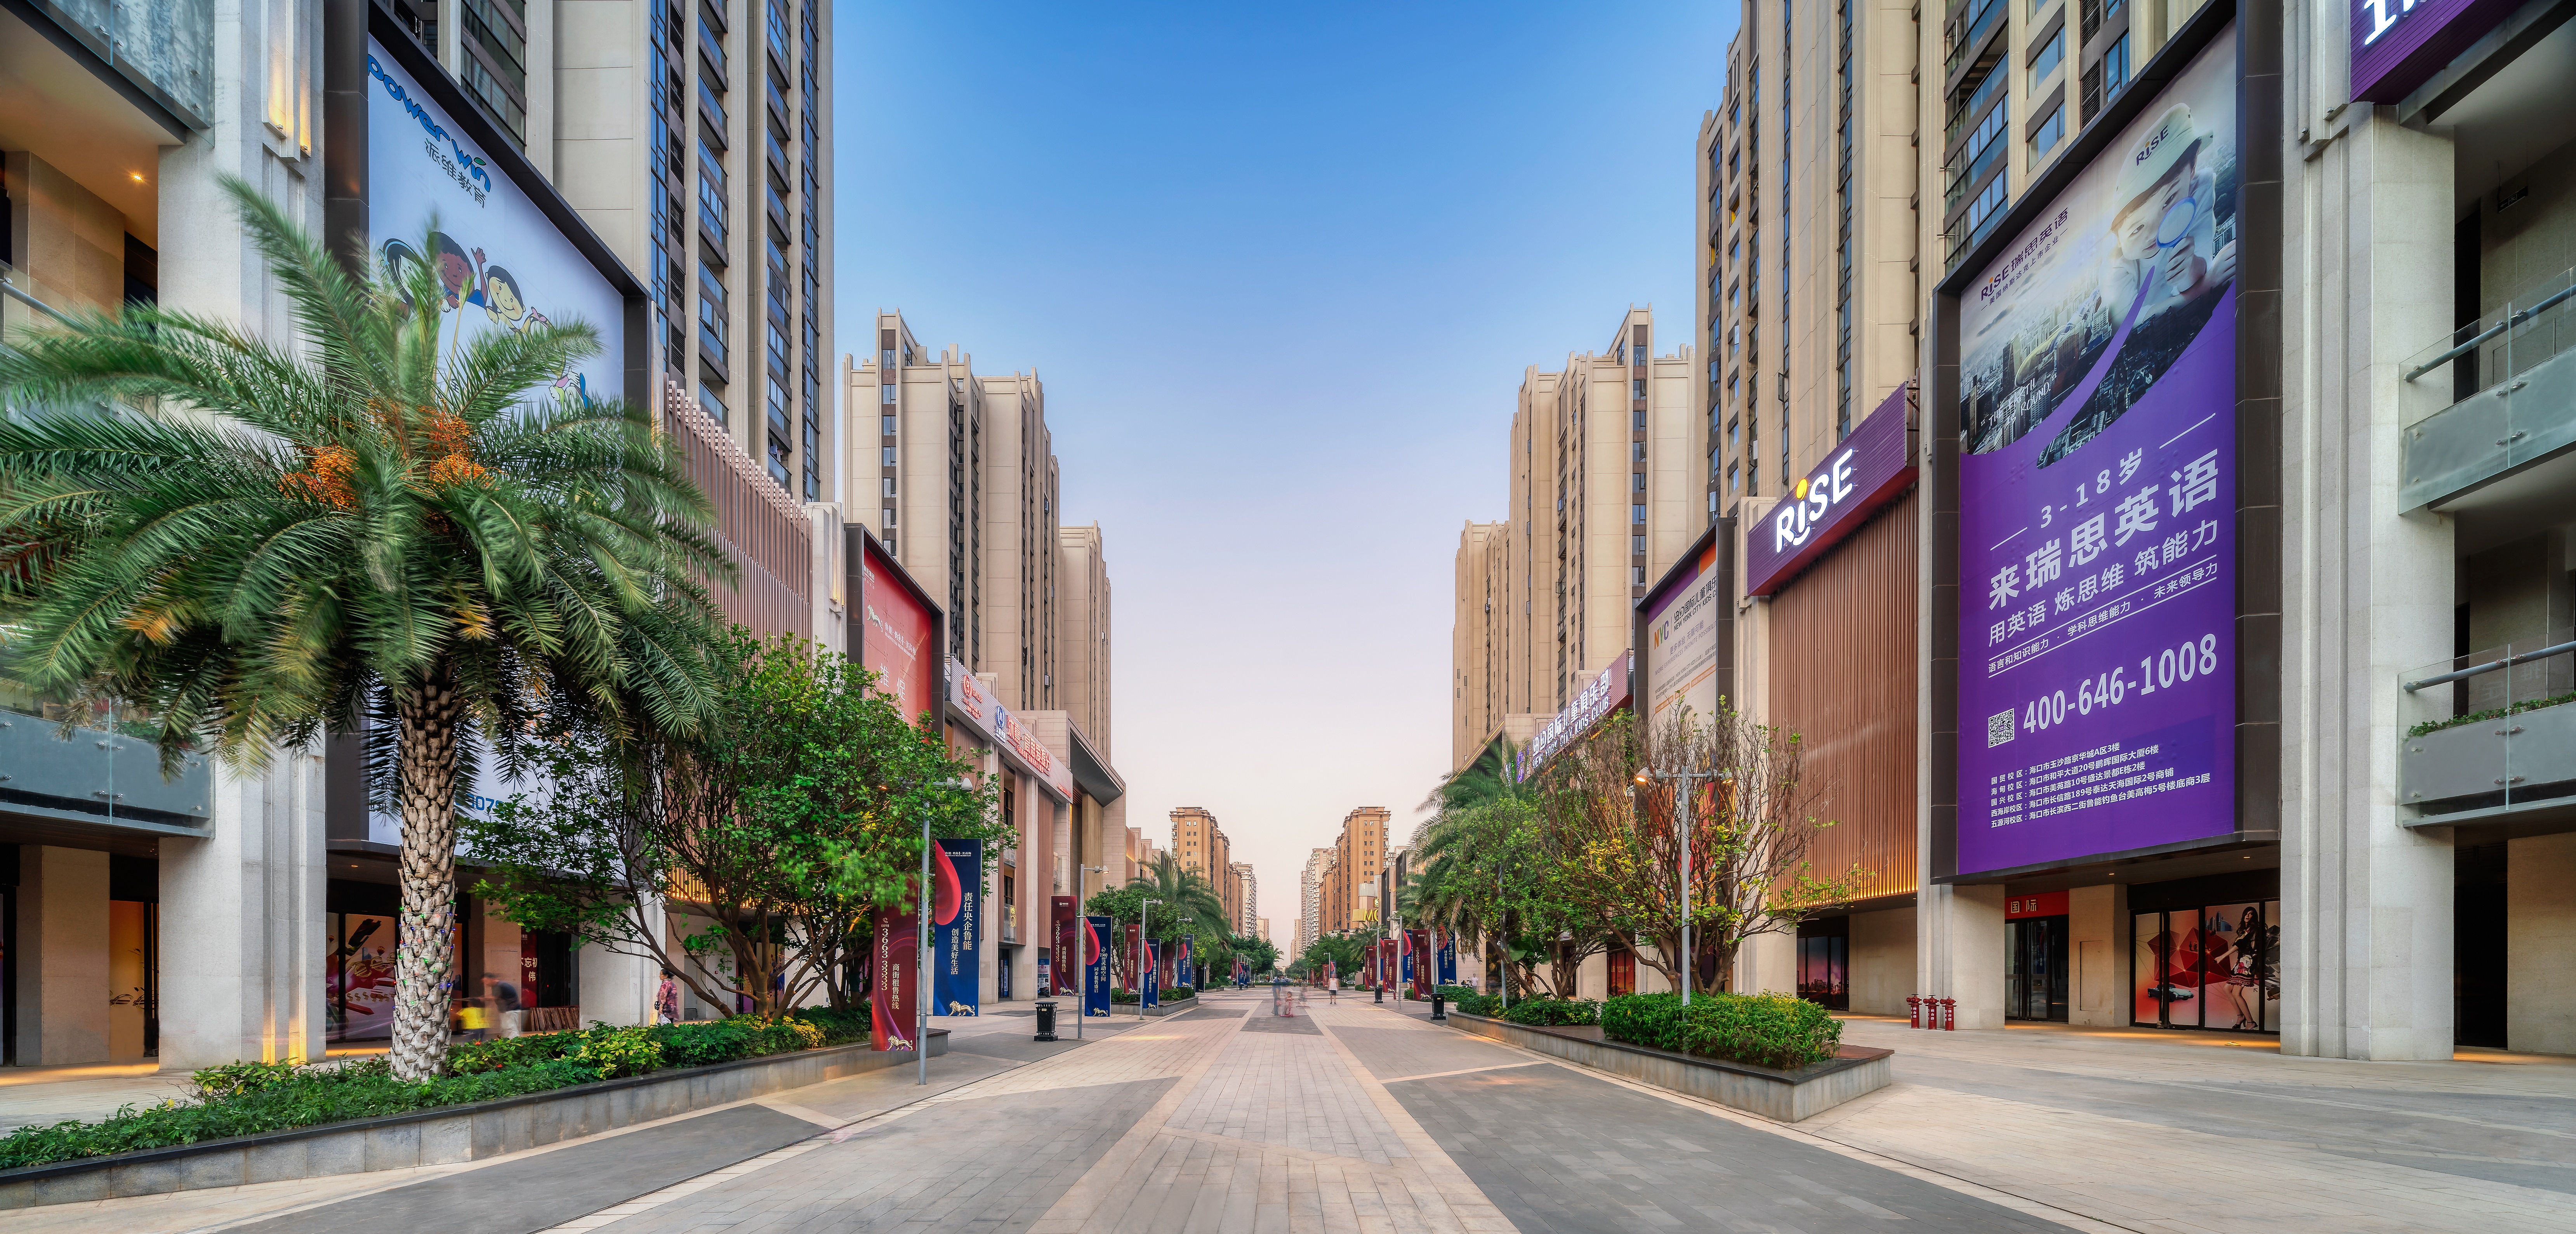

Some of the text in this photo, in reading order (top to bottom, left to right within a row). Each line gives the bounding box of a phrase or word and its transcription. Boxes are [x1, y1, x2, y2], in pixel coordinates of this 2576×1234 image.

[424, 138, 486, 209] 派维教育
[1989, 236, 2058, 306] 美国纳斯达克上市企业
[2011, 207, 2068, 273] 瑞思英语
[1989, 448, 2218, 611] 来瑞思英语
[1674, 620, 1682, 632] NEW
[1683, 610, 1692, 623] YORK
[1692, 602, 1702, 616] CITY
[1702, 594, 1711, 607] KIDS
[1988, 520, 2218, 648] 用英语 炼思维 筑能力
[1654, 620, 1669, 650] NYC
[1988, 563, 2218, 674] 语言和知识能力 学科思维能力 未来领导力
[1655, 664, 1664, 676] MORE
[1664, 650, 1683, 668] EXPERIENCES
[1684, 636, 1698, 652] INFINITE
[2024, 633, 2217, 733] 400-646-1008
[1533, 668, 1609, 757] 纽约国际儿童俱乐部
[1591, 695, 1609, 721] CLUB
[963, 892, 973, 950] 责任央企鲁能
[2011, 899, 2036, 913] 国际
[951, 928, 959, 975] 创造美好生活
[892, 963, 900, 1010] 商街租售热线
